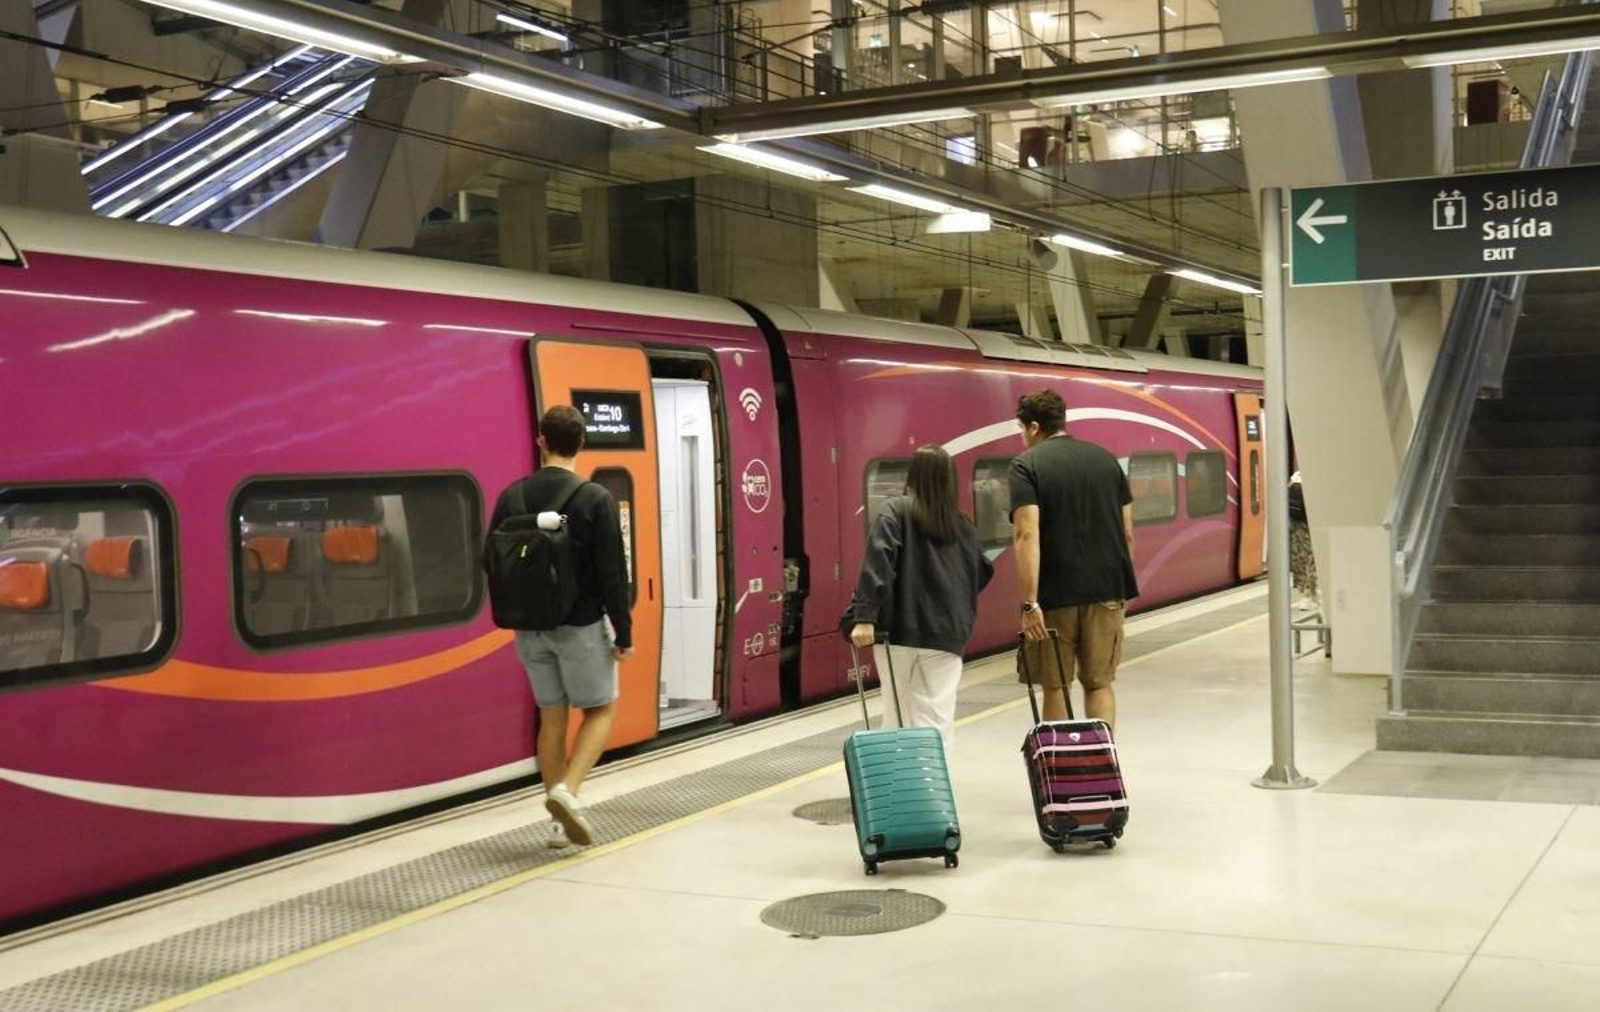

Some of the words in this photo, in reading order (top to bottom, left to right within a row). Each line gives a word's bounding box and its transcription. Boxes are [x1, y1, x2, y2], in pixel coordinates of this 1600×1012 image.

[1482, 188, 1559, 212] Salida
[1482, 217, 1553, 241] Saída
[1482, 247, 1517, 261] EXIT
[608, 406, 622, 421] 10
